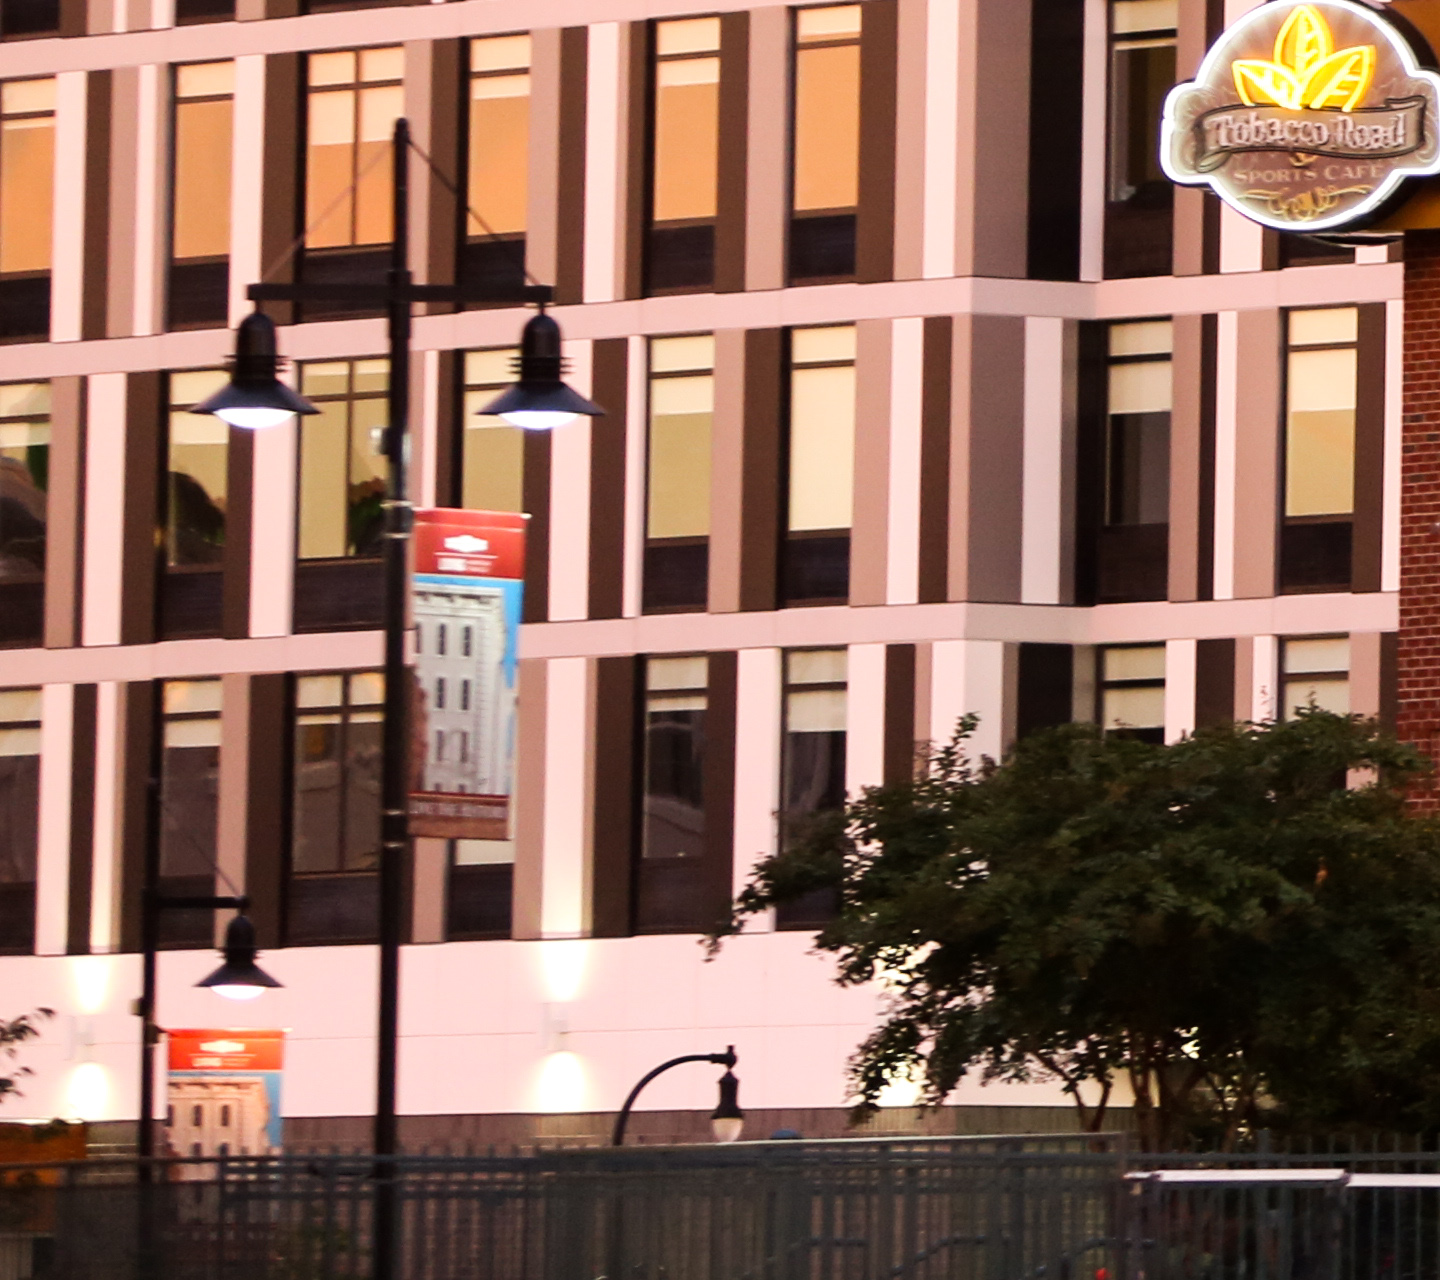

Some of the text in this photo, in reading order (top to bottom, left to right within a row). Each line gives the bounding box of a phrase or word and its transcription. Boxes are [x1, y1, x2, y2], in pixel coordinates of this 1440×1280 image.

[1210, 110, 1406, 151] Tobacco Road
[1233, 168, 1316, 184] SPORTS
